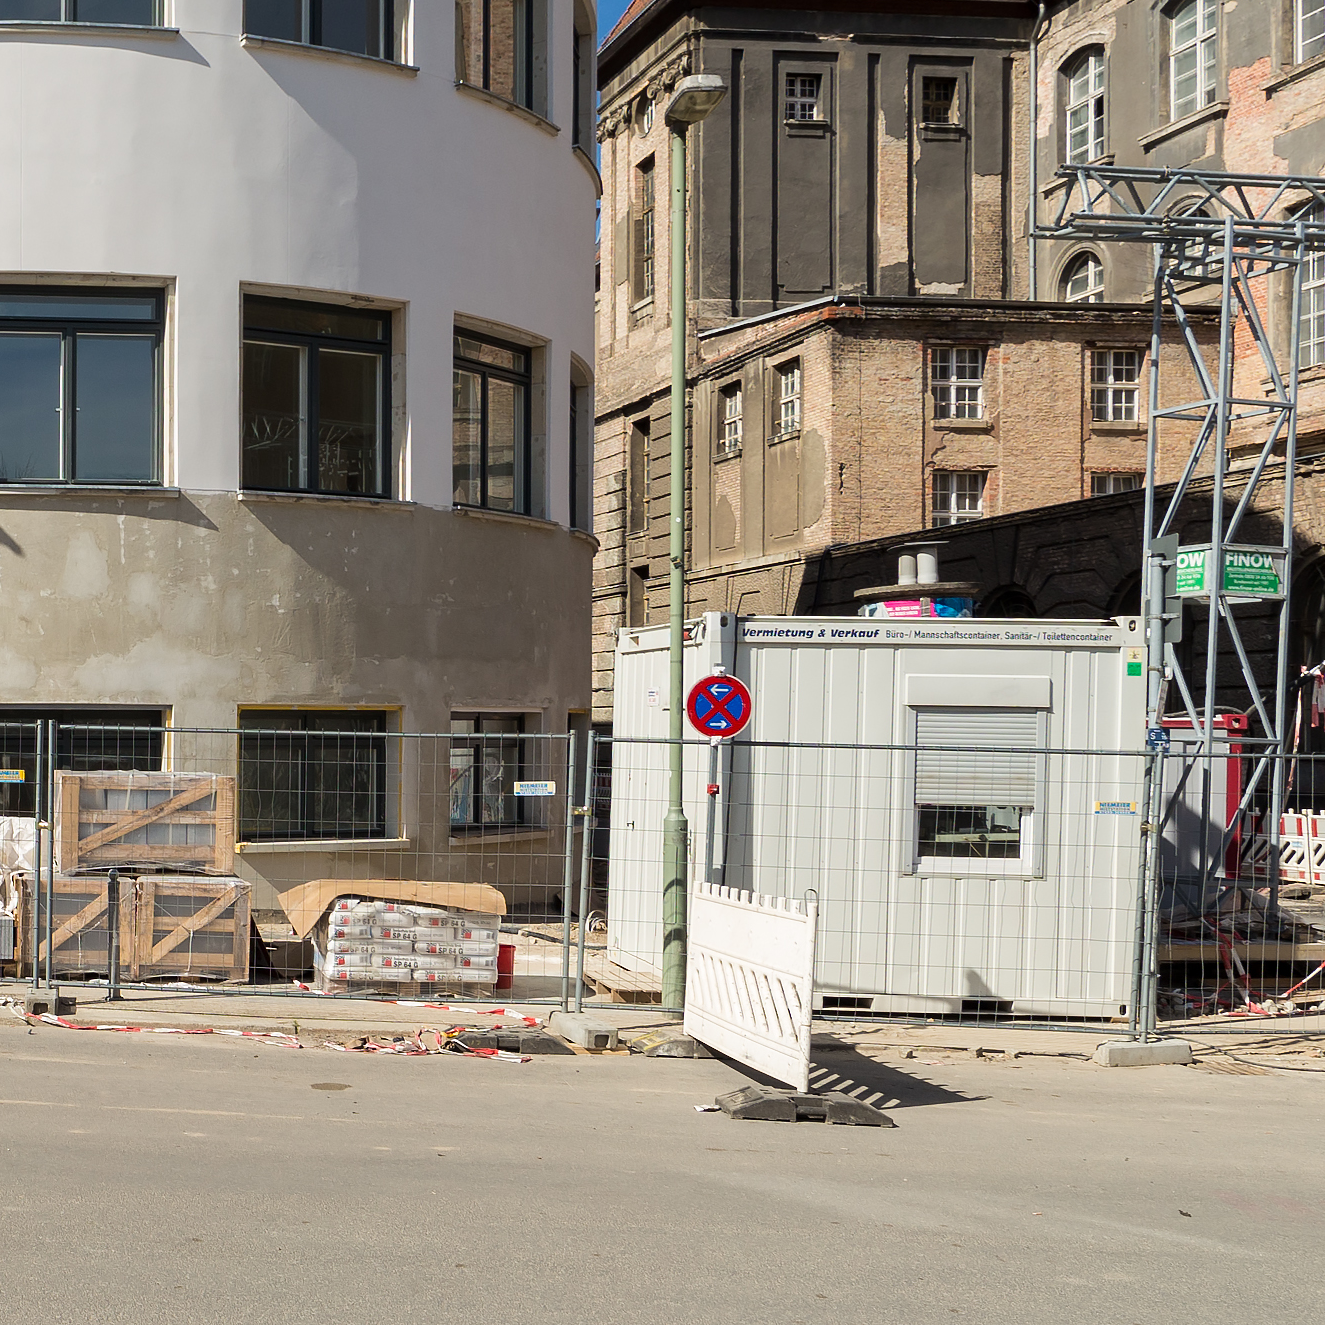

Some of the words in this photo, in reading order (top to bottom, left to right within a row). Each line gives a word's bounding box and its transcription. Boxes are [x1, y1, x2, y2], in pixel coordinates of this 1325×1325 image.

[742, 627, 814, 639] Vermietung
[817, 628, 826, 638] &
[830, 628, 880, 638] Verkauf
[1042, 631, 1113, 642] Toilettencontainer
[393, 960, 403, 968] SP
